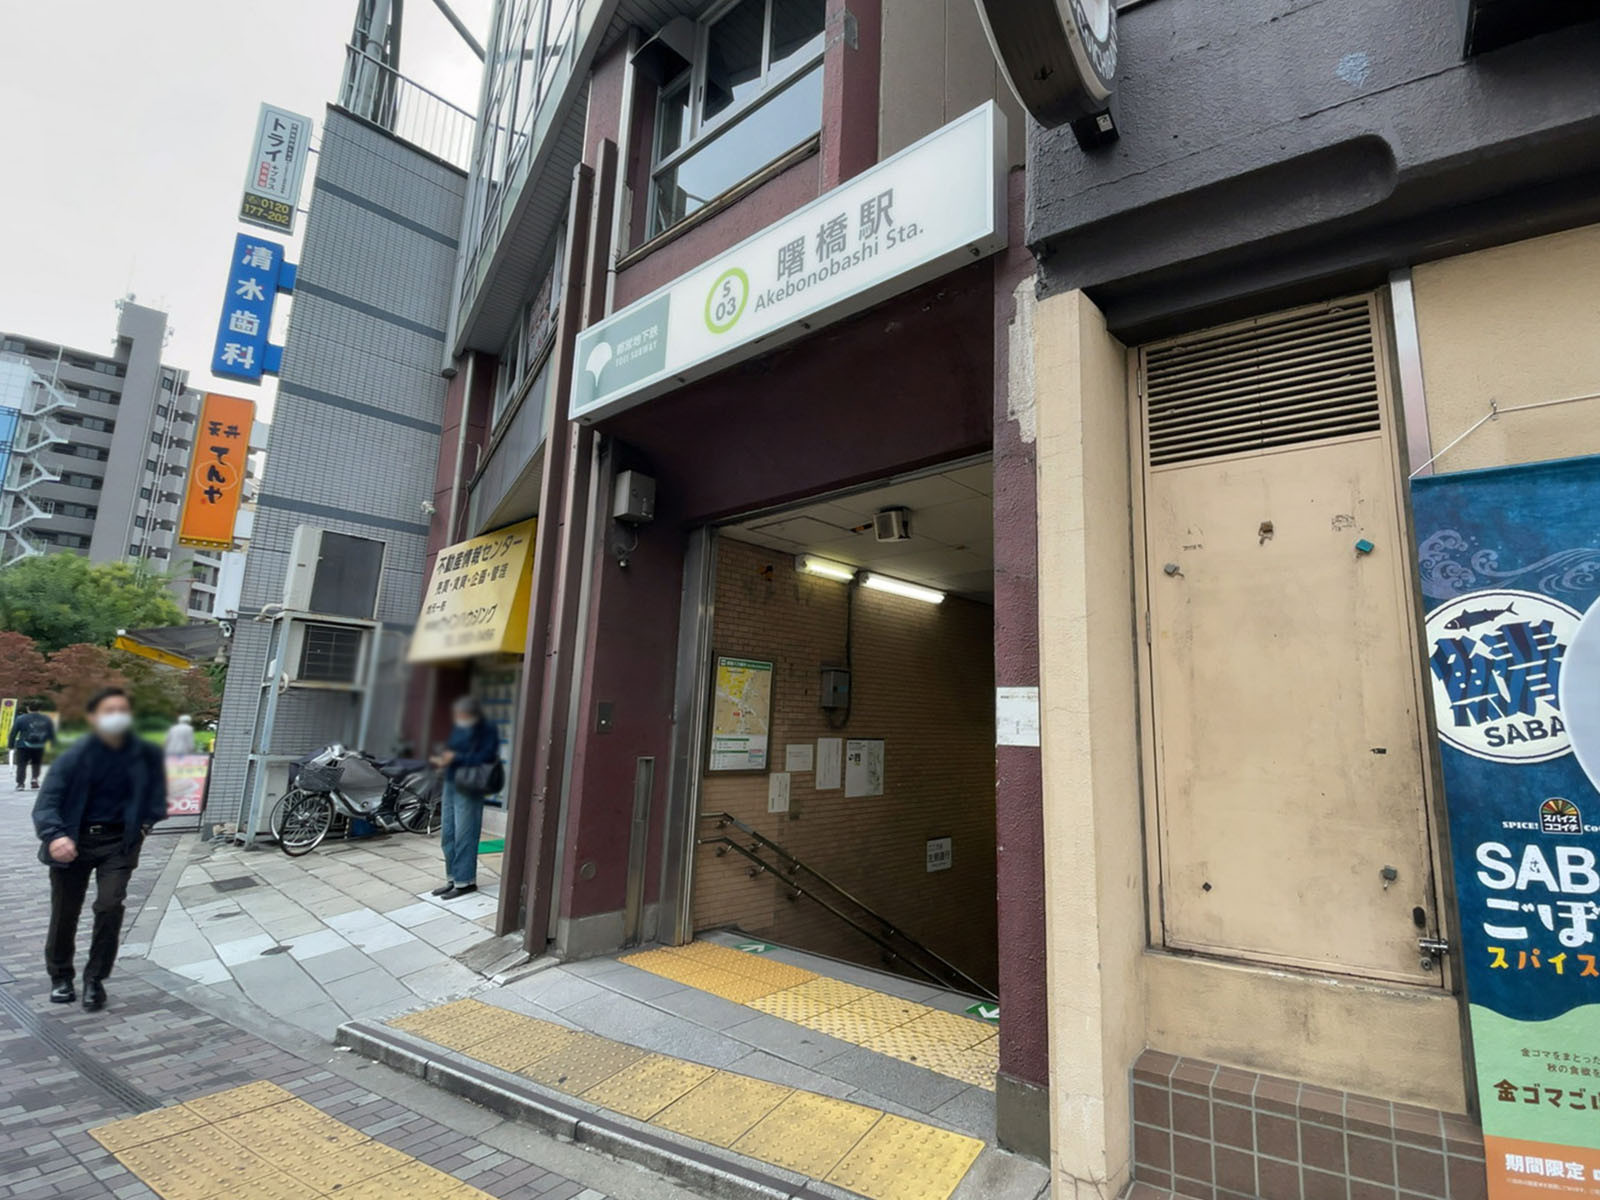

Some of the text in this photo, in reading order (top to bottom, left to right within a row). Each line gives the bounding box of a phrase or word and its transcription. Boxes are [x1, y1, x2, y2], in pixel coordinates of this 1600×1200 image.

[244, 203, 289, 224] 177-202
[261, 198, 289, 214] 0120
[776, 188, 897, 281] 曙橋駅
[754, 223, 925, 313] Akebonobashi Sta.
[722, 280, 731, 298] S
[221, 245, 273, 370] 清水歯科
[715, 297, 737, 321] 03
[204, 446, 230, 504] てんや
[436, 534, 523, 575] 不動産情報センター
[1502, 821, 1539, 830] SPICE!
[1543, 814, 1578, 824] スパイス
[1544, 823, 1579, 832] ココイチ
[1476, 841, 1600, 895] SAB
[1483, 898, 1600, 948] ごぼ
[1487, 946, 1600, 977] スパイス
[1504, 1153, 1586, 1181] 期間限定
